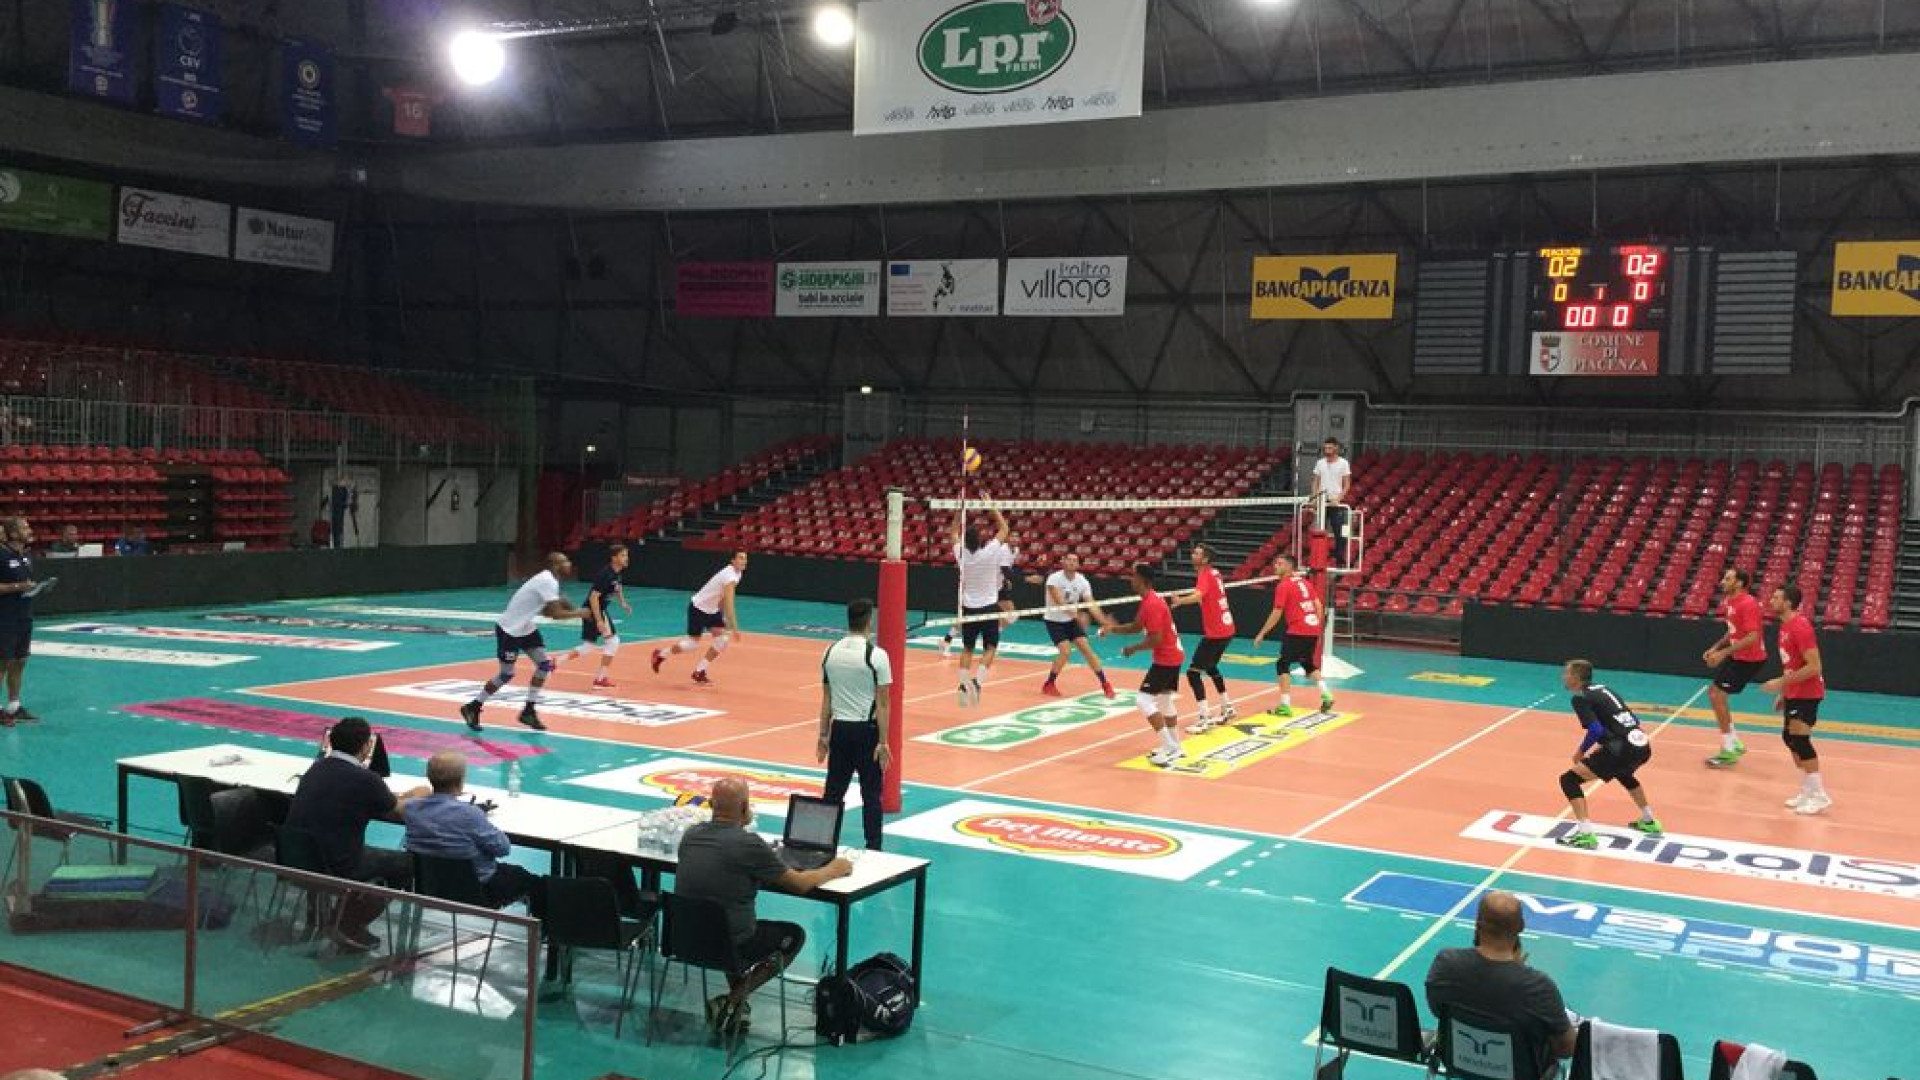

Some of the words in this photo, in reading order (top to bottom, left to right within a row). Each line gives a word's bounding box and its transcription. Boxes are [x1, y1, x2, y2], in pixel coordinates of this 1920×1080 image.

[941, 27, 1050, 74] Lpr
[1547, 257, 1579, 277] 02
[1627, 254, 1658, 275] 02
[1020, 268, 1111, 304] village
[1554, 283, 1568, 302] 0
[1634, 282, 1649, 301] 0
[1612, 306, 1630, 327] 0
[1581, 334, 1645, 347] COMUNE
[1574, 360, 1650, 372] PIACENZA
